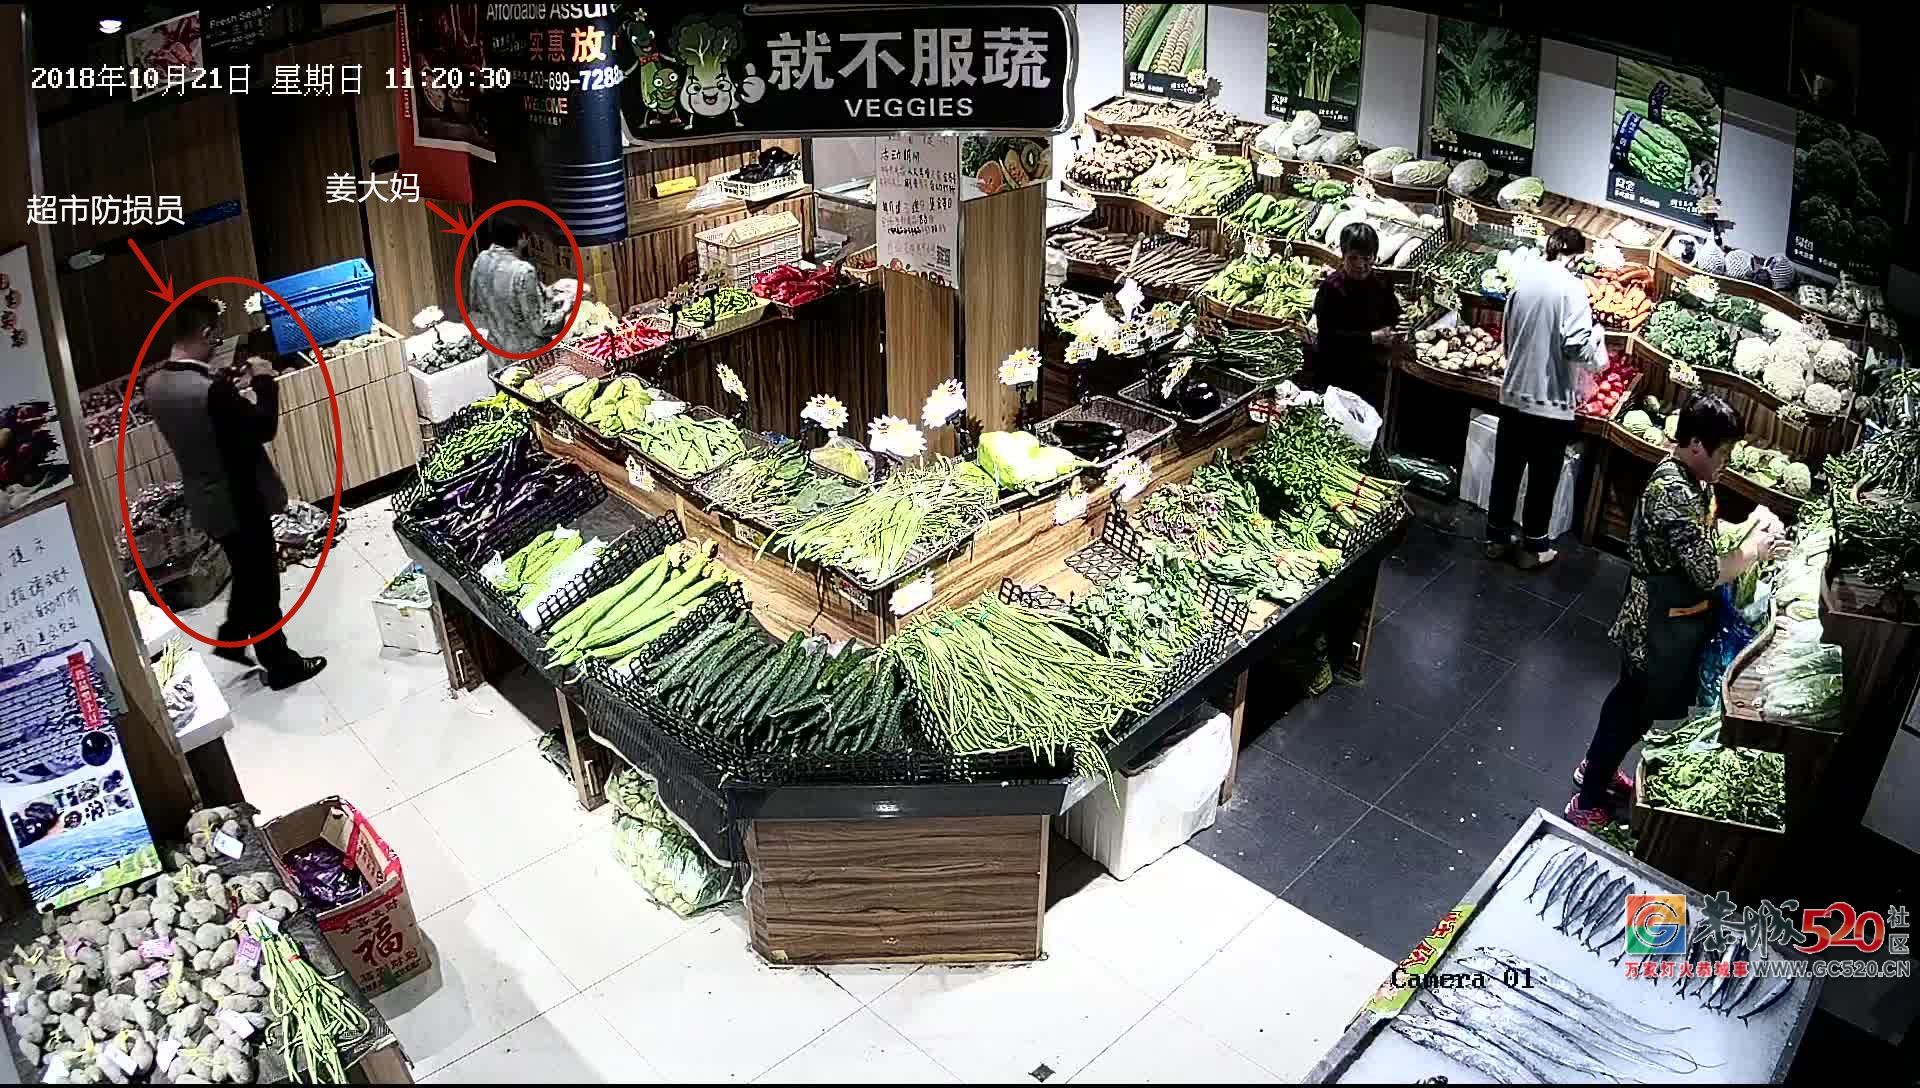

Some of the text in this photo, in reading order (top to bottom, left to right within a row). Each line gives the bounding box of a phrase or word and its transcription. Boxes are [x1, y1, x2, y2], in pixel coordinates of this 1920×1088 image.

[767, 27, 1051, 90] 就不服蔬
[845, 98, 974, 118] VEGGIES
[352, 915, 403, 967] 福
